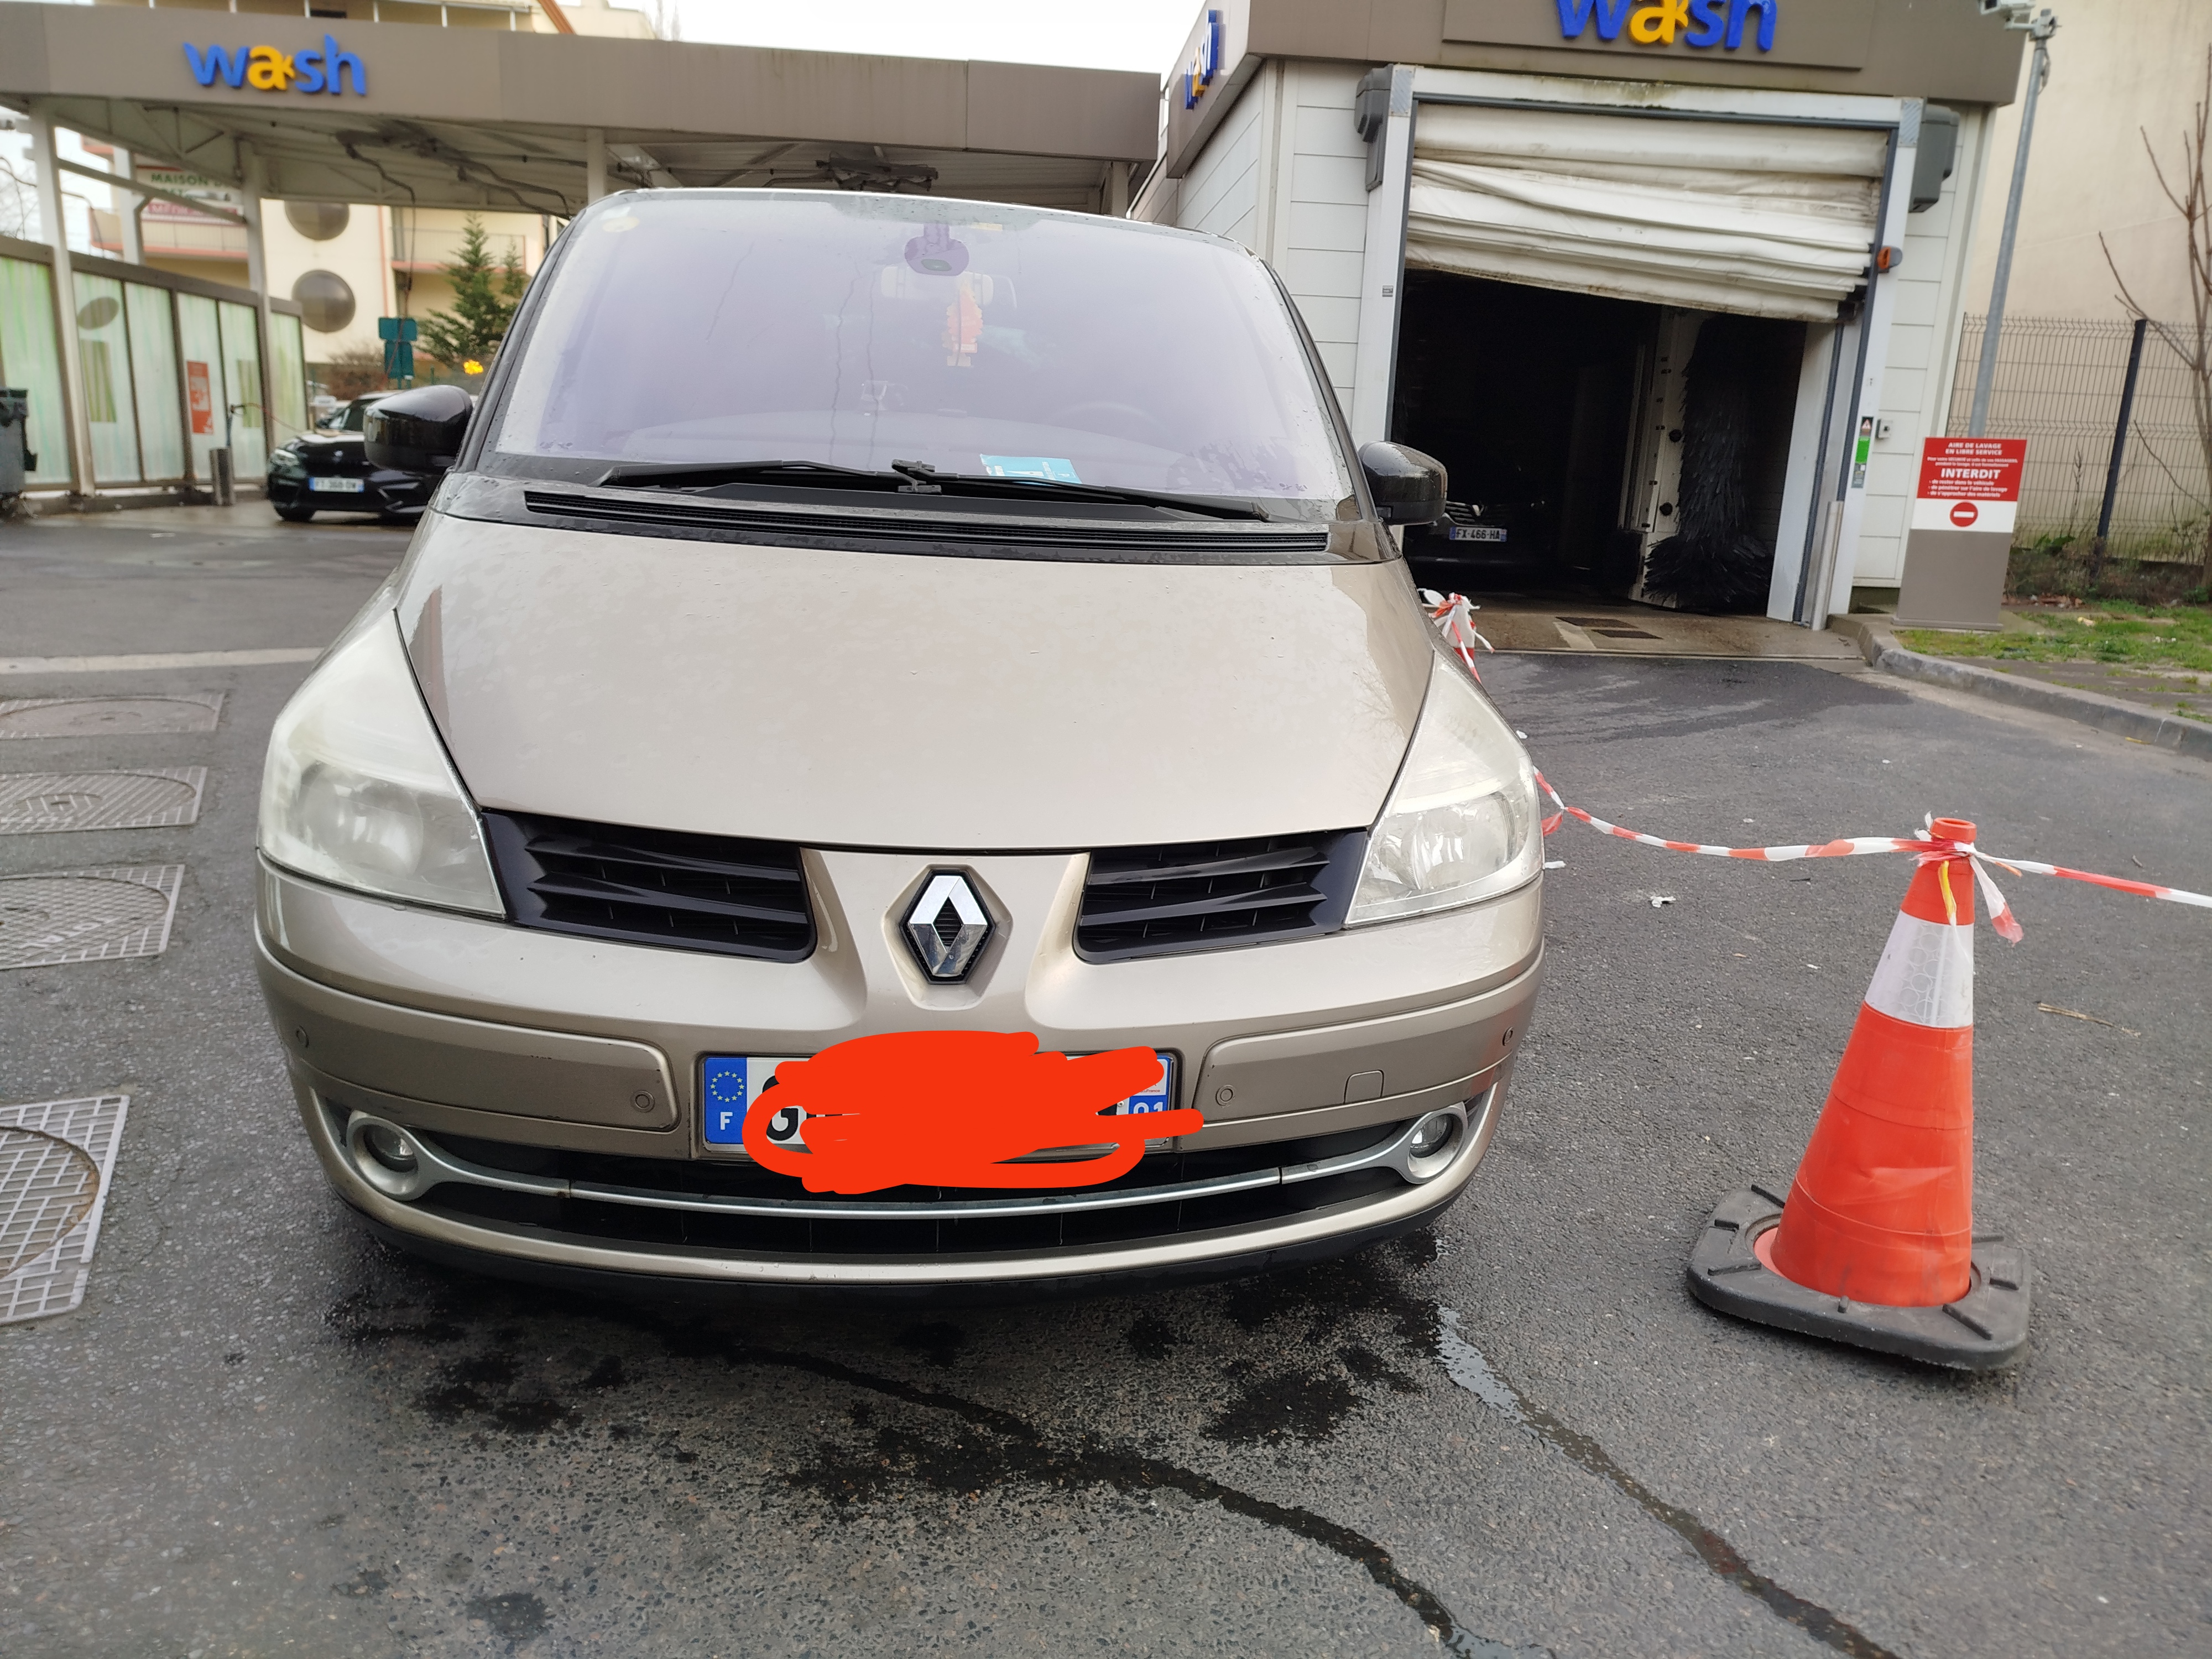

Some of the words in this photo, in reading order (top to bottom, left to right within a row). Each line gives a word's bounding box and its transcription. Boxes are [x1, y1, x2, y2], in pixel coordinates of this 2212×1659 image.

[1557, 0, 1777, 52] wash
[182, 34, 367, 96] wash
[151, 173, 208, 186] MAISON
[1940, 468, 2001, 479] INTERDIT
[721, 1112, 733, 1130] F
